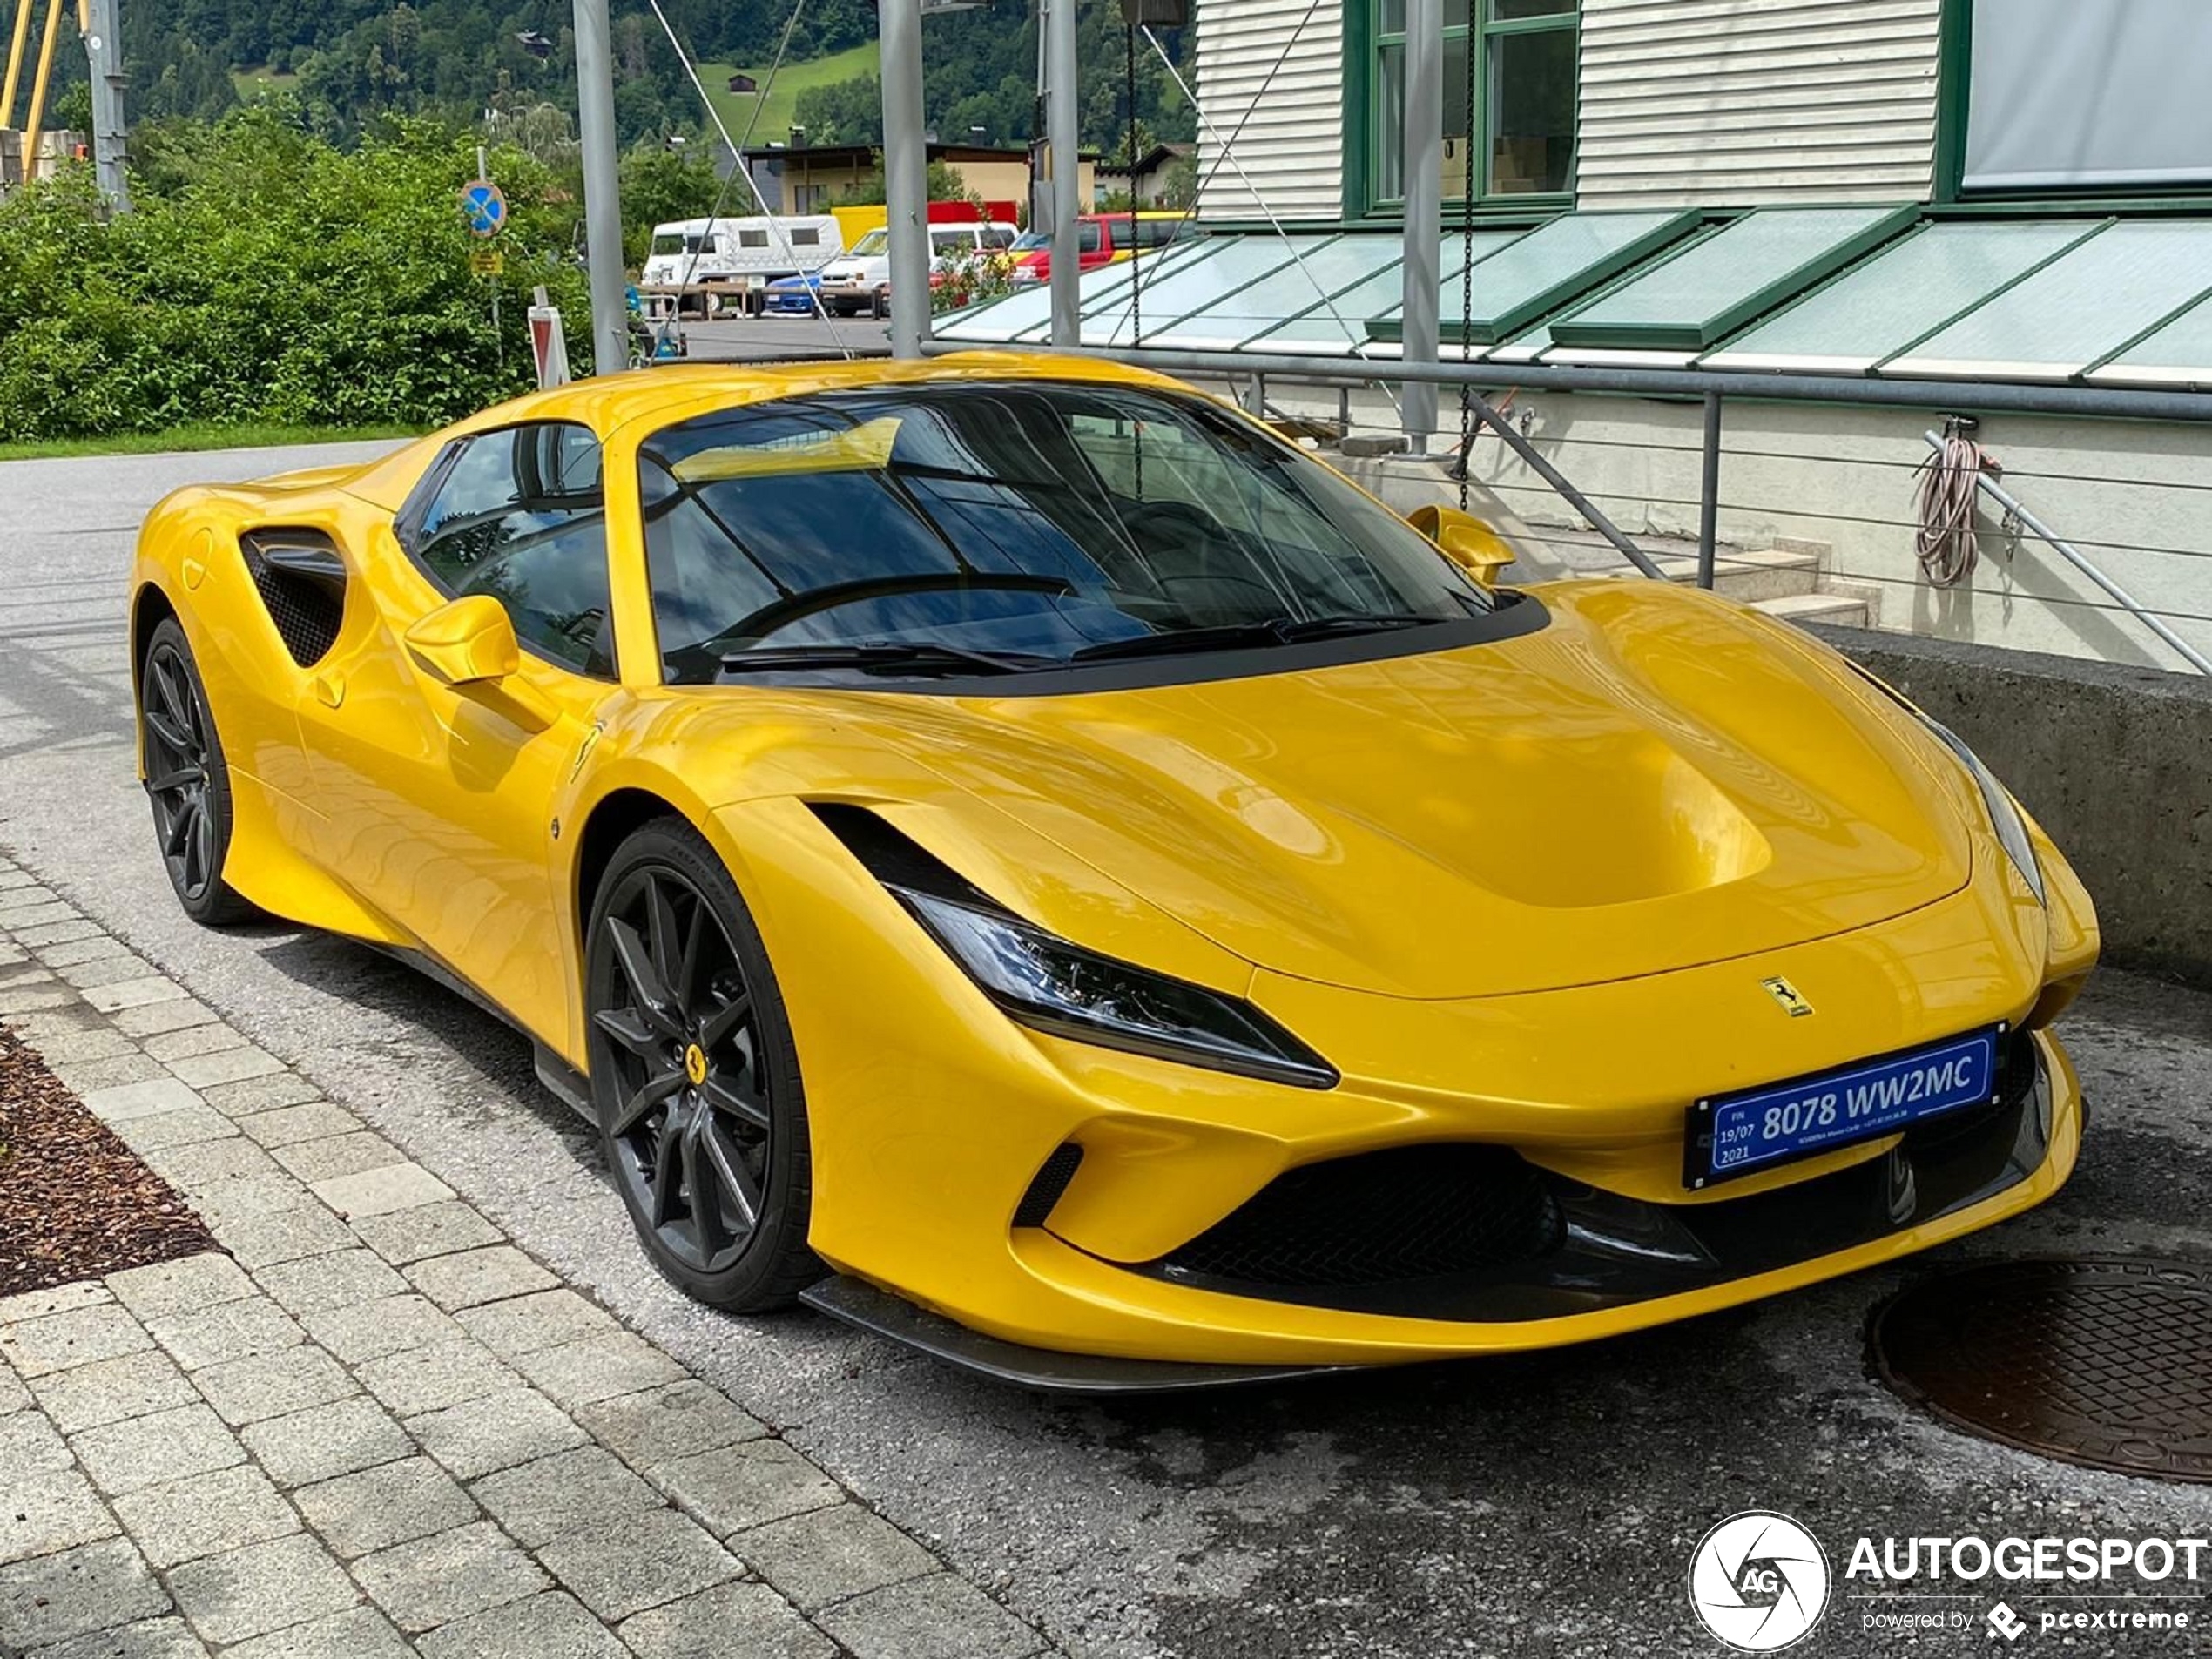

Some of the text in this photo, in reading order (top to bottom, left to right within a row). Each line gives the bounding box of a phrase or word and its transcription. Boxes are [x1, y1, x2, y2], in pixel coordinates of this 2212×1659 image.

[1763, 1094, 1837, 1140] 8078
[1846, 1056, 1973, 1118] WW2MC
[1720, 1124, 1755, 1143] 19/07
[1721, 1146, 1749, 1163] 2021
